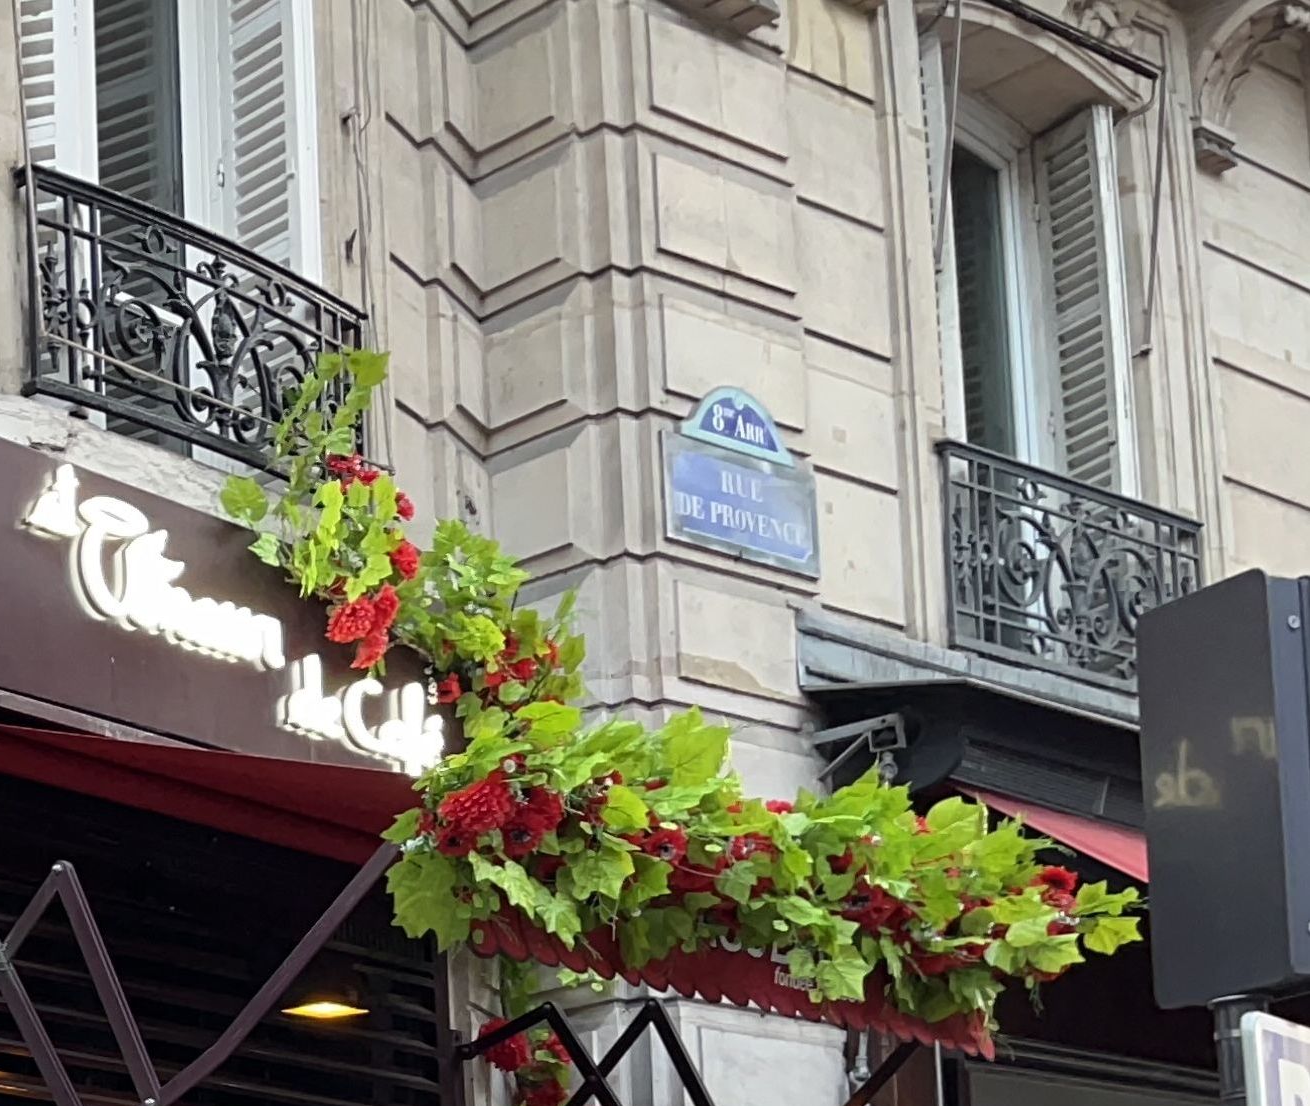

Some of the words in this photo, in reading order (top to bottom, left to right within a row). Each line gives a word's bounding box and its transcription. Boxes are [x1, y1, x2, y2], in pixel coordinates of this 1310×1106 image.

[721, 470, 763, 503] RUE
[675, 491, 705, 520] DE
[710, 501, 807, 545] PROVENCE
